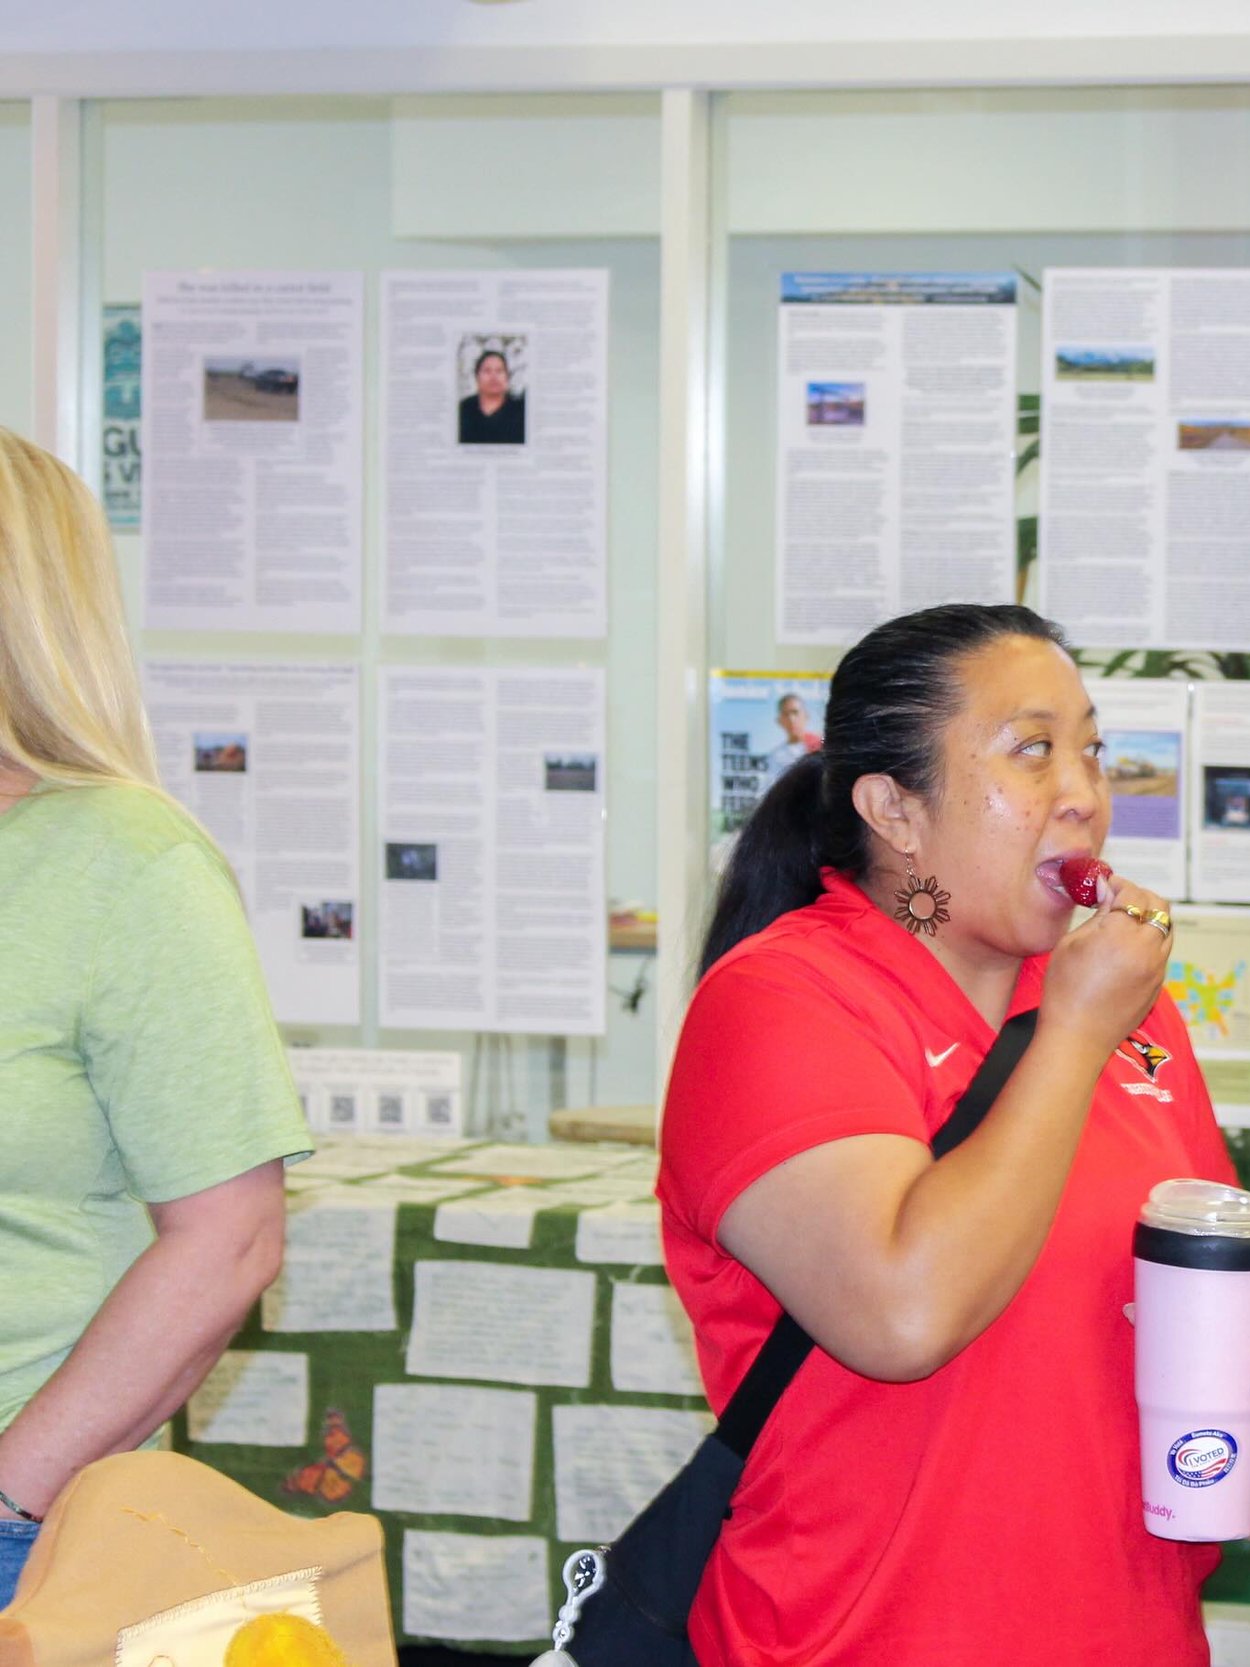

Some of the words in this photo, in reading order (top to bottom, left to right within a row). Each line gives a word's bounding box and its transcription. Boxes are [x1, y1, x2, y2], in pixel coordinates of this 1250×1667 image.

[721, 732, 749, 749] THE
[721, 754, 769, 771] TEENS
[722, 776, 760, 791] WHO
[1193, 1447, 1225, 1464] VOTED
